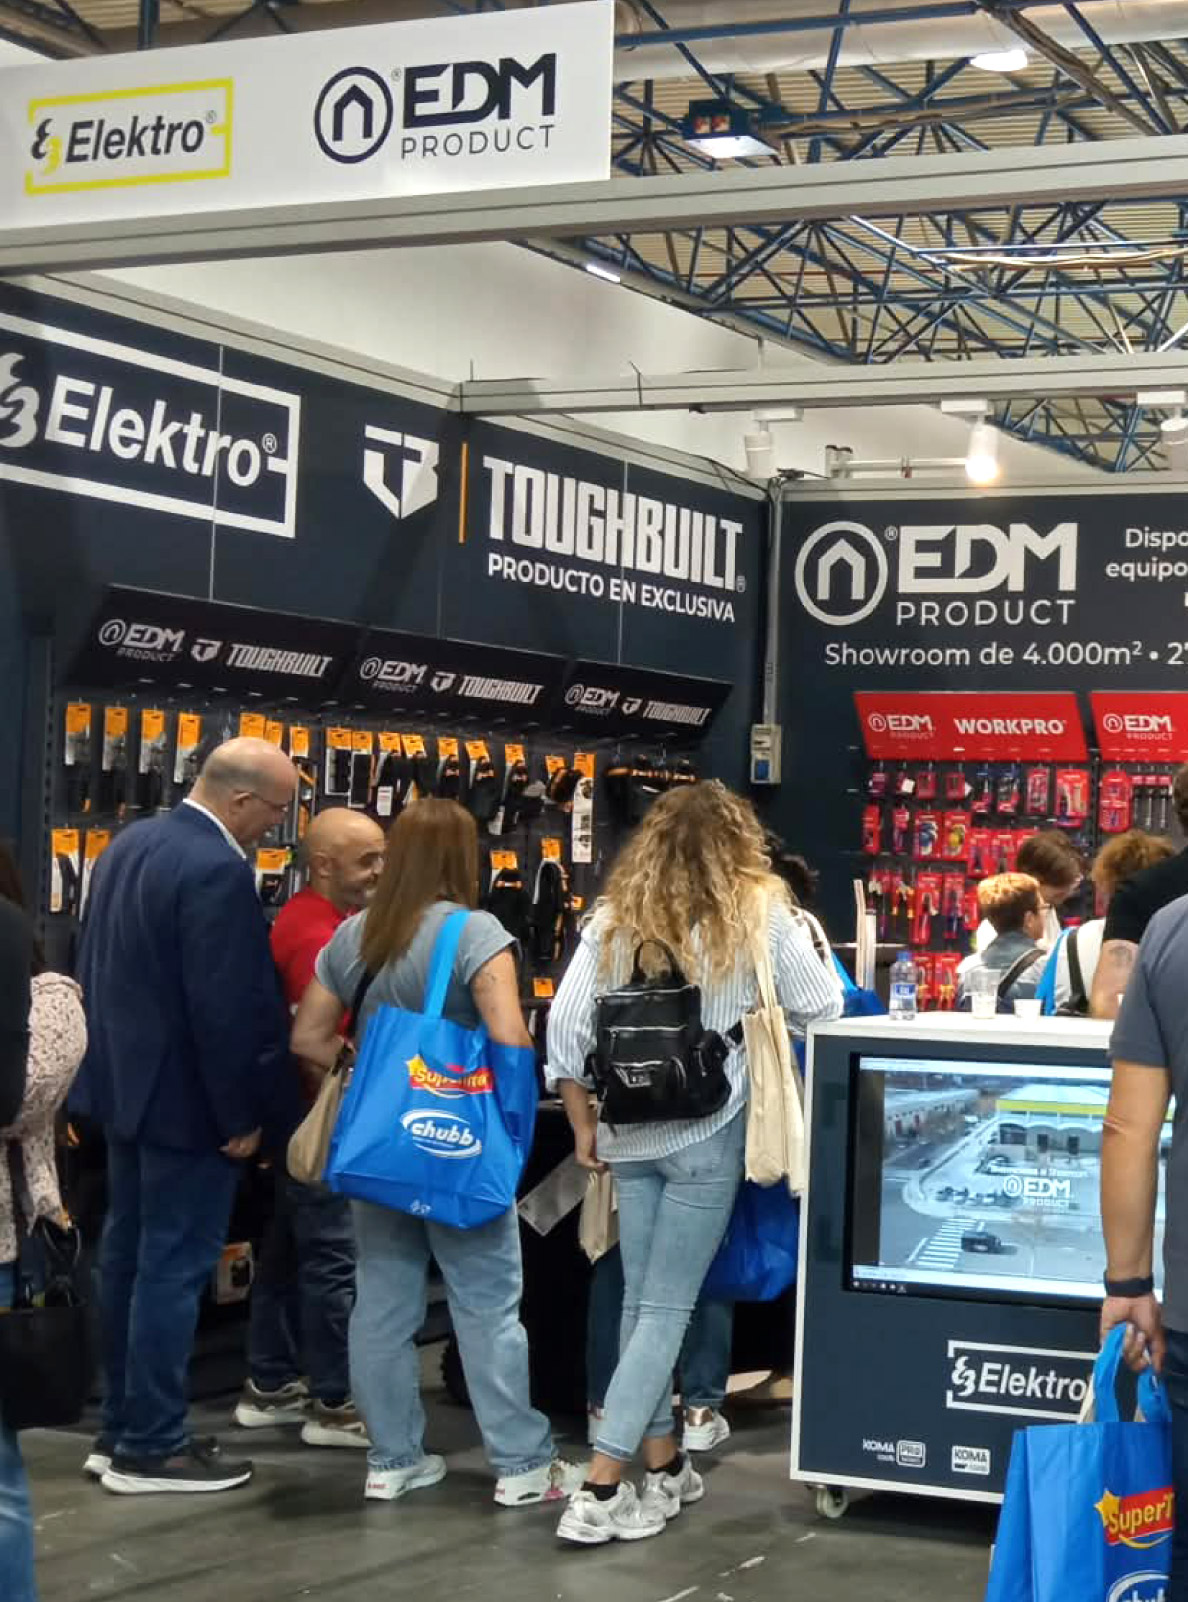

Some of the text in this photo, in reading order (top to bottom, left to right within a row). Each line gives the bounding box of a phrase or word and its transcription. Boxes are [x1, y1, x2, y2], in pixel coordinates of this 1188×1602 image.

[403, 52, 557, 129] EDM
[65, 115, 203, 163] Elektro
[401, 124, 555, 160] PRODUCT
[45, 374, 262, 487] Elektro
[483, 455, 743, 590] TOUGHBUILT
[898, 522, 1078, 593] EDM
[1105, 558, 1188, 583] equipo
[488, 553, 736, 623] PRODUCTO EN EXCLUSIVA
[896, 599, 1076, 626] PRODUCT
[123, 624, 333, 678] EDM TOUGHBUILT
[825, 642, 971, 666] Showroom
[979, 641, 1014, 665] de
[378, 660, 428, 684] EDM
[580, 686, 621, 707] EDM
[887, 715, 1065, 735] EDM WORKPRO
[1124, 715, 1173, 732] EDM
[412, 1120, 474, 1146] chubb
[1023, 1178, 1071, 1198] EDM
[978, 1362, 1087, 1402] Elektro
[955, 1449, 988, 1462] KOMA
